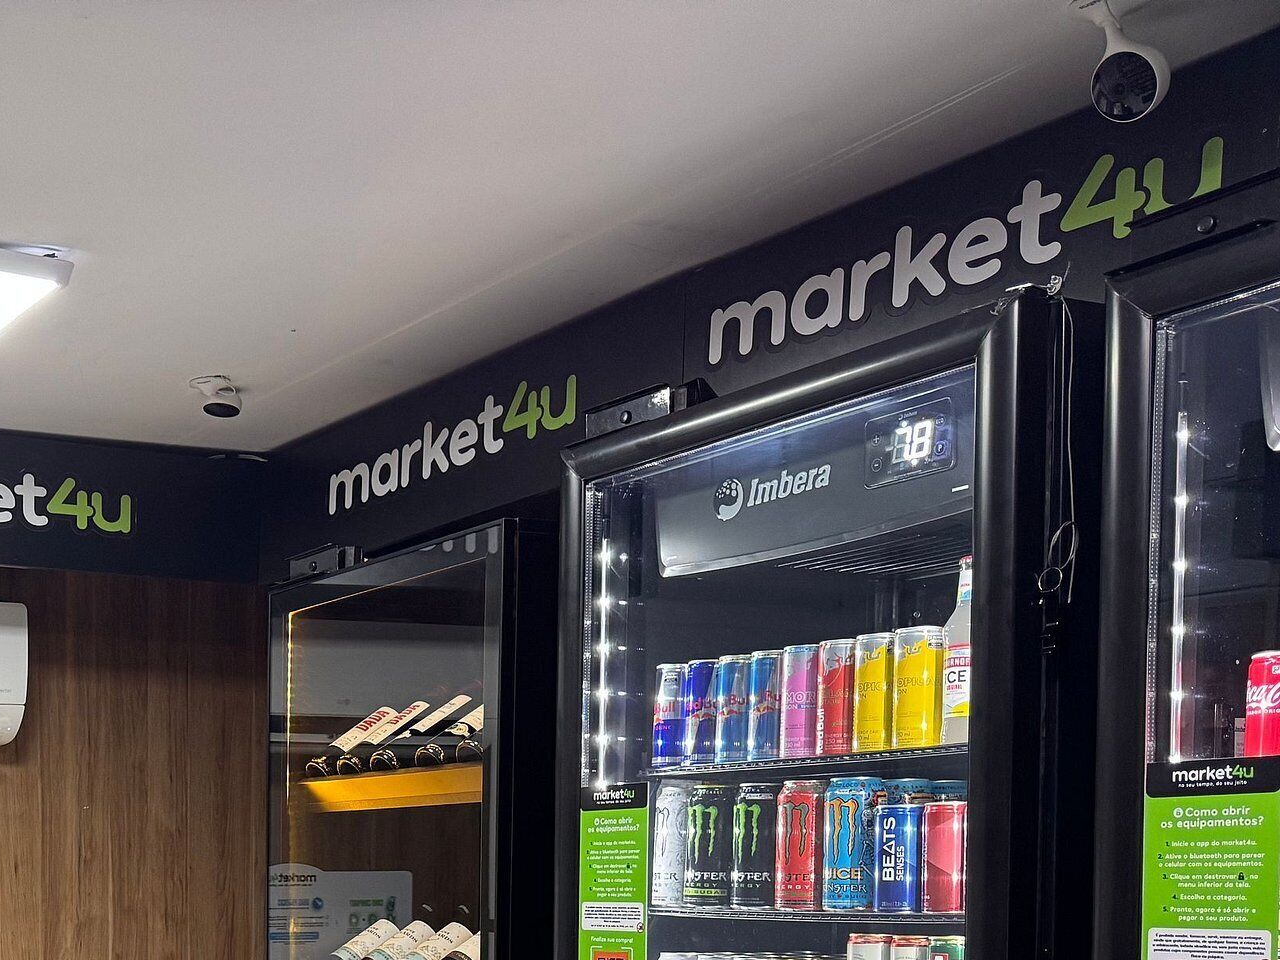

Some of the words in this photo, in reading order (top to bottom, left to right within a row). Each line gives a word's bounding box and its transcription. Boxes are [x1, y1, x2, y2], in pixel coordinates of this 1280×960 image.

[708, 137, 1224, 365] market4u
[329, 375, 576, 515] market4u
[747, 463, 831, 507] Imbera
[1172, 764, 1254, 782] market4u
[593, 788, 635, 800] market4u
[1177, 816, 1264, 829] equipamentos?
[1185, 808, 1218, 817] Como
[1222, 805, 1250, 816] abrir
[883, 817, 896, 881] BEATS
[896, 846, 905, 881] SENSES
